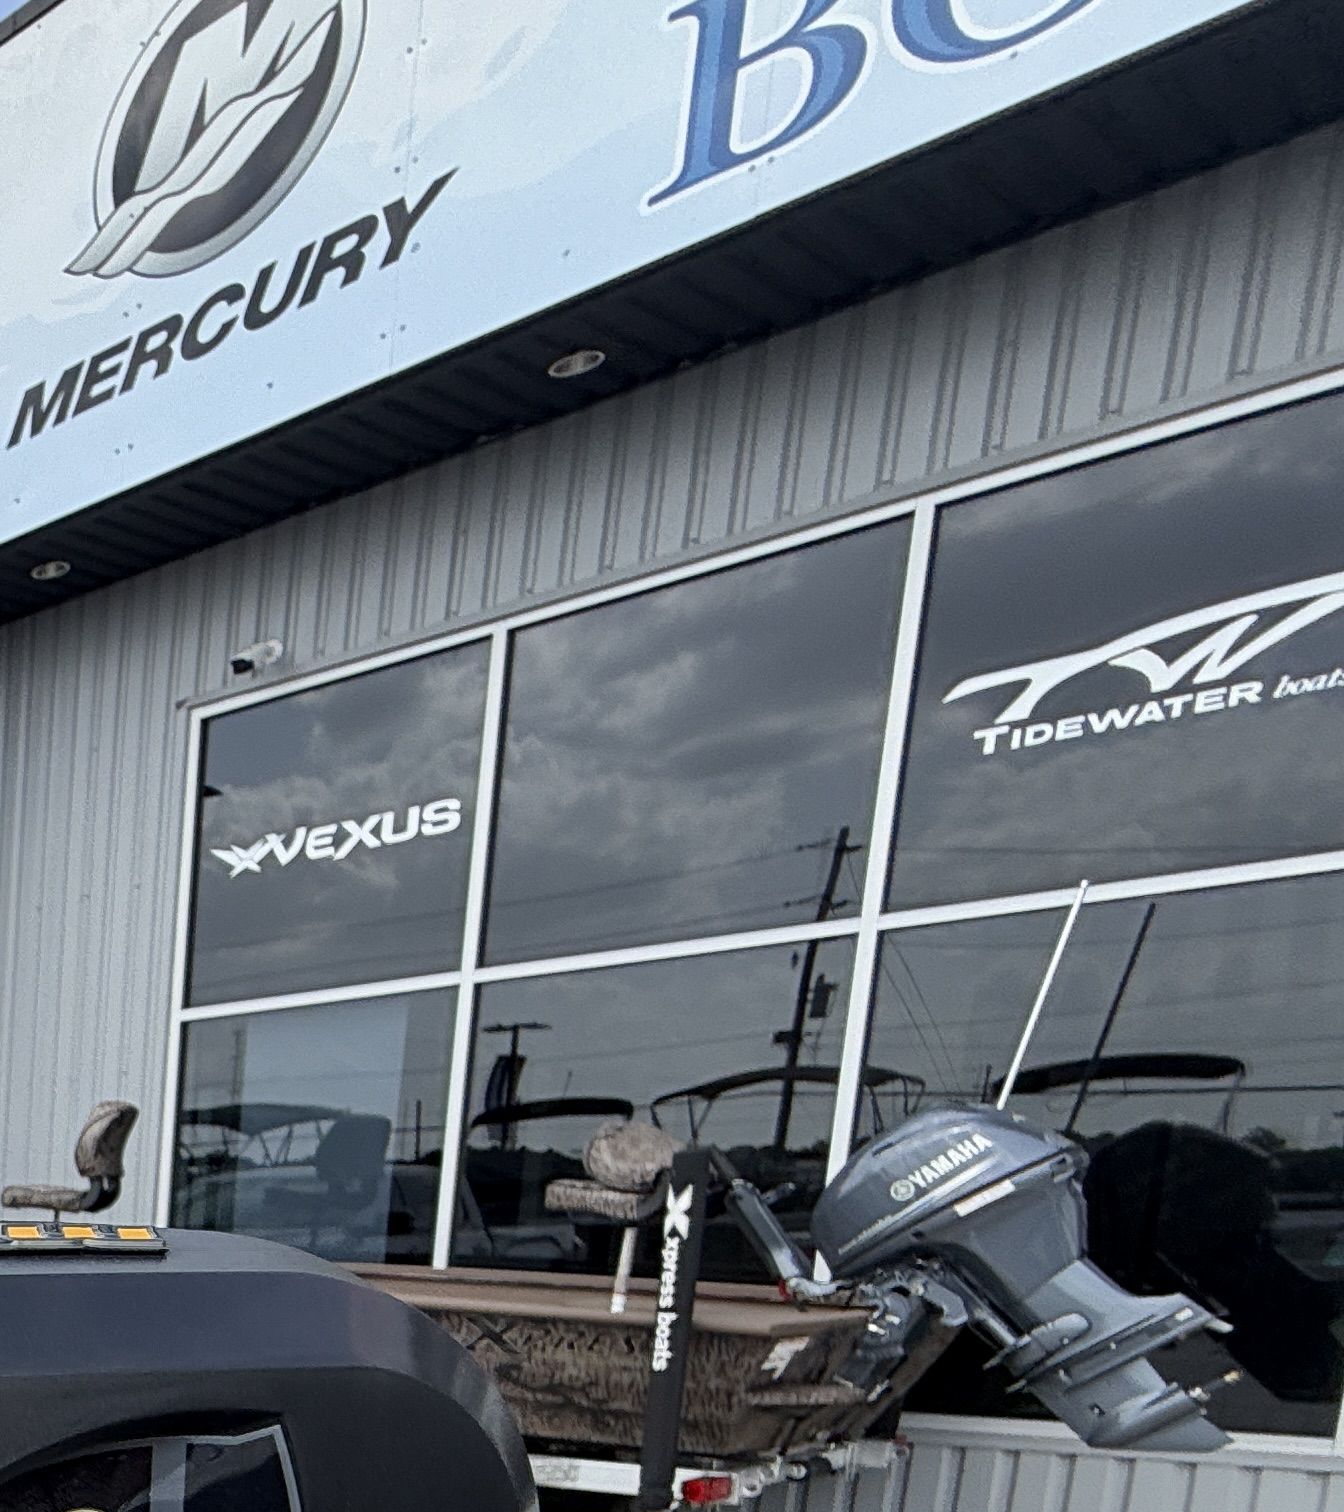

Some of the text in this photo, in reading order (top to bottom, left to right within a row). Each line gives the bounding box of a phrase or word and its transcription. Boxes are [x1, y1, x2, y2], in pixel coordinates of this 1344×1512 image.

[6, 166, 460, 449] MERCURY
[973, 680, 1265, 756] TIDEWATER
[262, 798, 462, 867] VEXUS
[907, 1132, 994, 1188] YAMAHA
